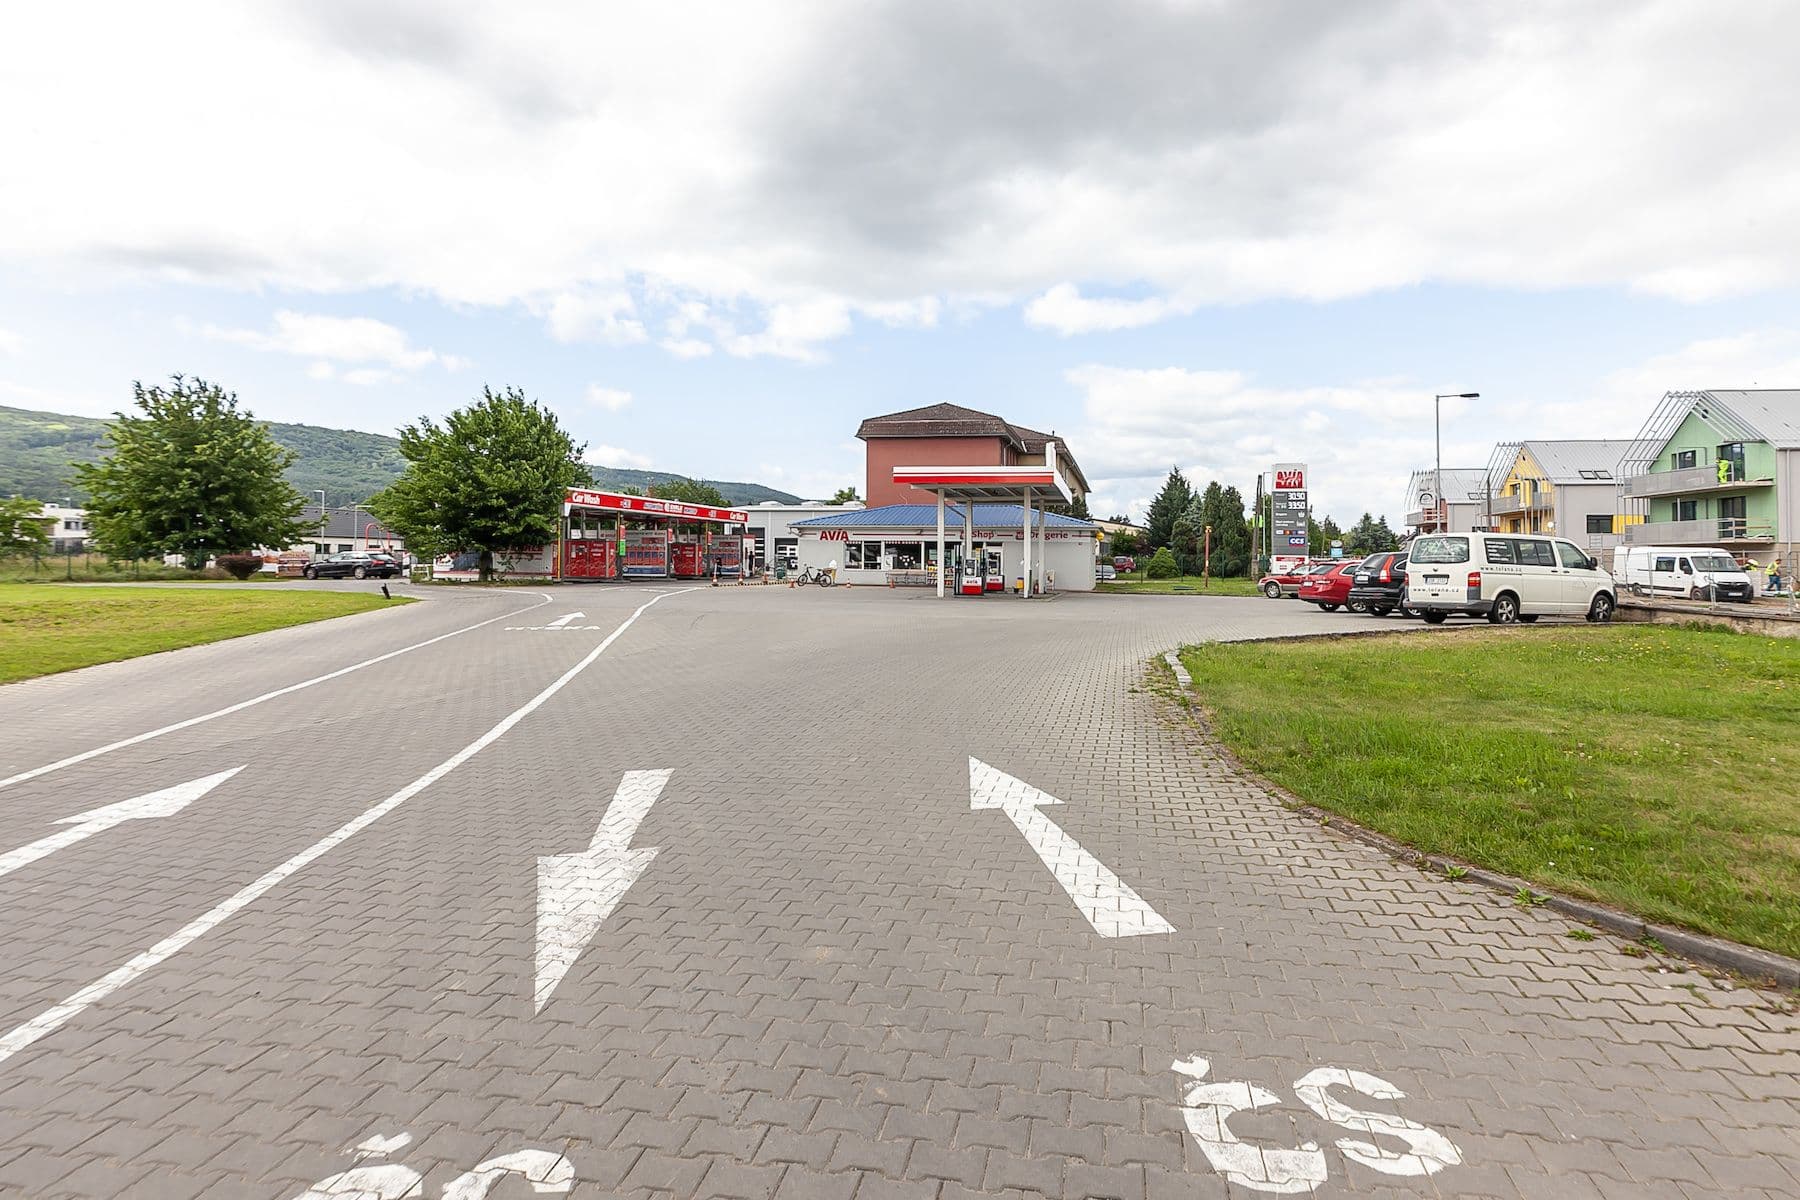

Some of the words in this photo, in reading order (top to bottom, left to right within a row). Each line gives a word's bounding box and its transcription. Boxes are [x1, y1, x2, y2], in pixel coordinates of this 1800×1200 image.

[572, 492, 584, 502] Car
[584, 493, 600, 505] Wash
[972, 530, 994, 540] Shop
[1170, 1055, 1463, 1194] ČS
